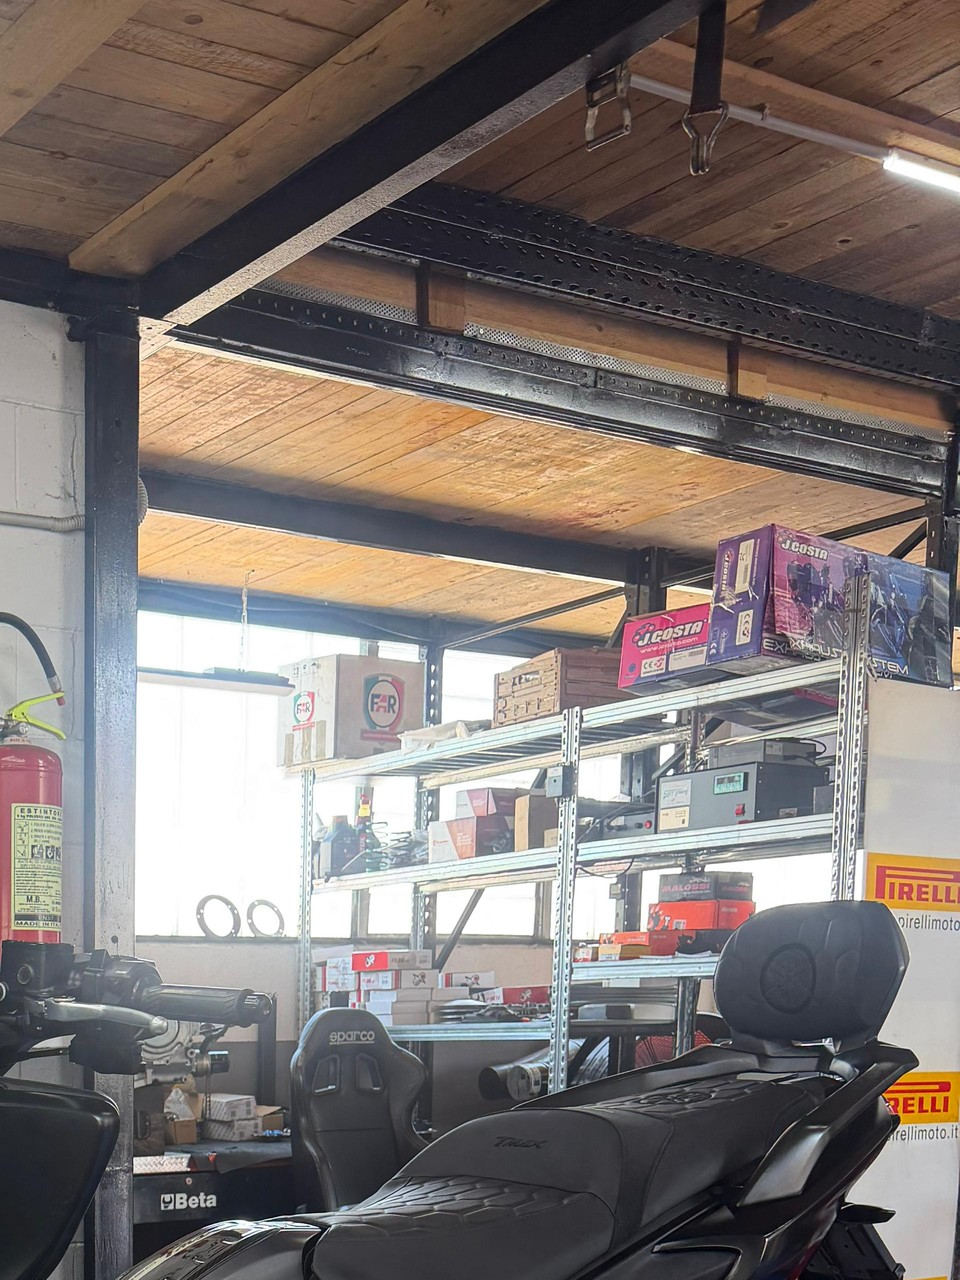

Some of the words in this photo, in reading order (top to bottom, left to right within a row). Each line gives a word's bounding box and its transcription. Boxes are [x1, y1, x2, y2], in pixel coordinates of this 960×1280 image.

[781, 540, 829, 560] J.COSTA
[637, 620, 704, 648] J.COSTA
[296, 701, 311, 715] FAR
[370, 693, 397, 714] FAR
[660, 883, 710, 893] MALOSSI
[329, 1030, 375, 1045] sparco
[175, 1192, 217, 1210] Beta
